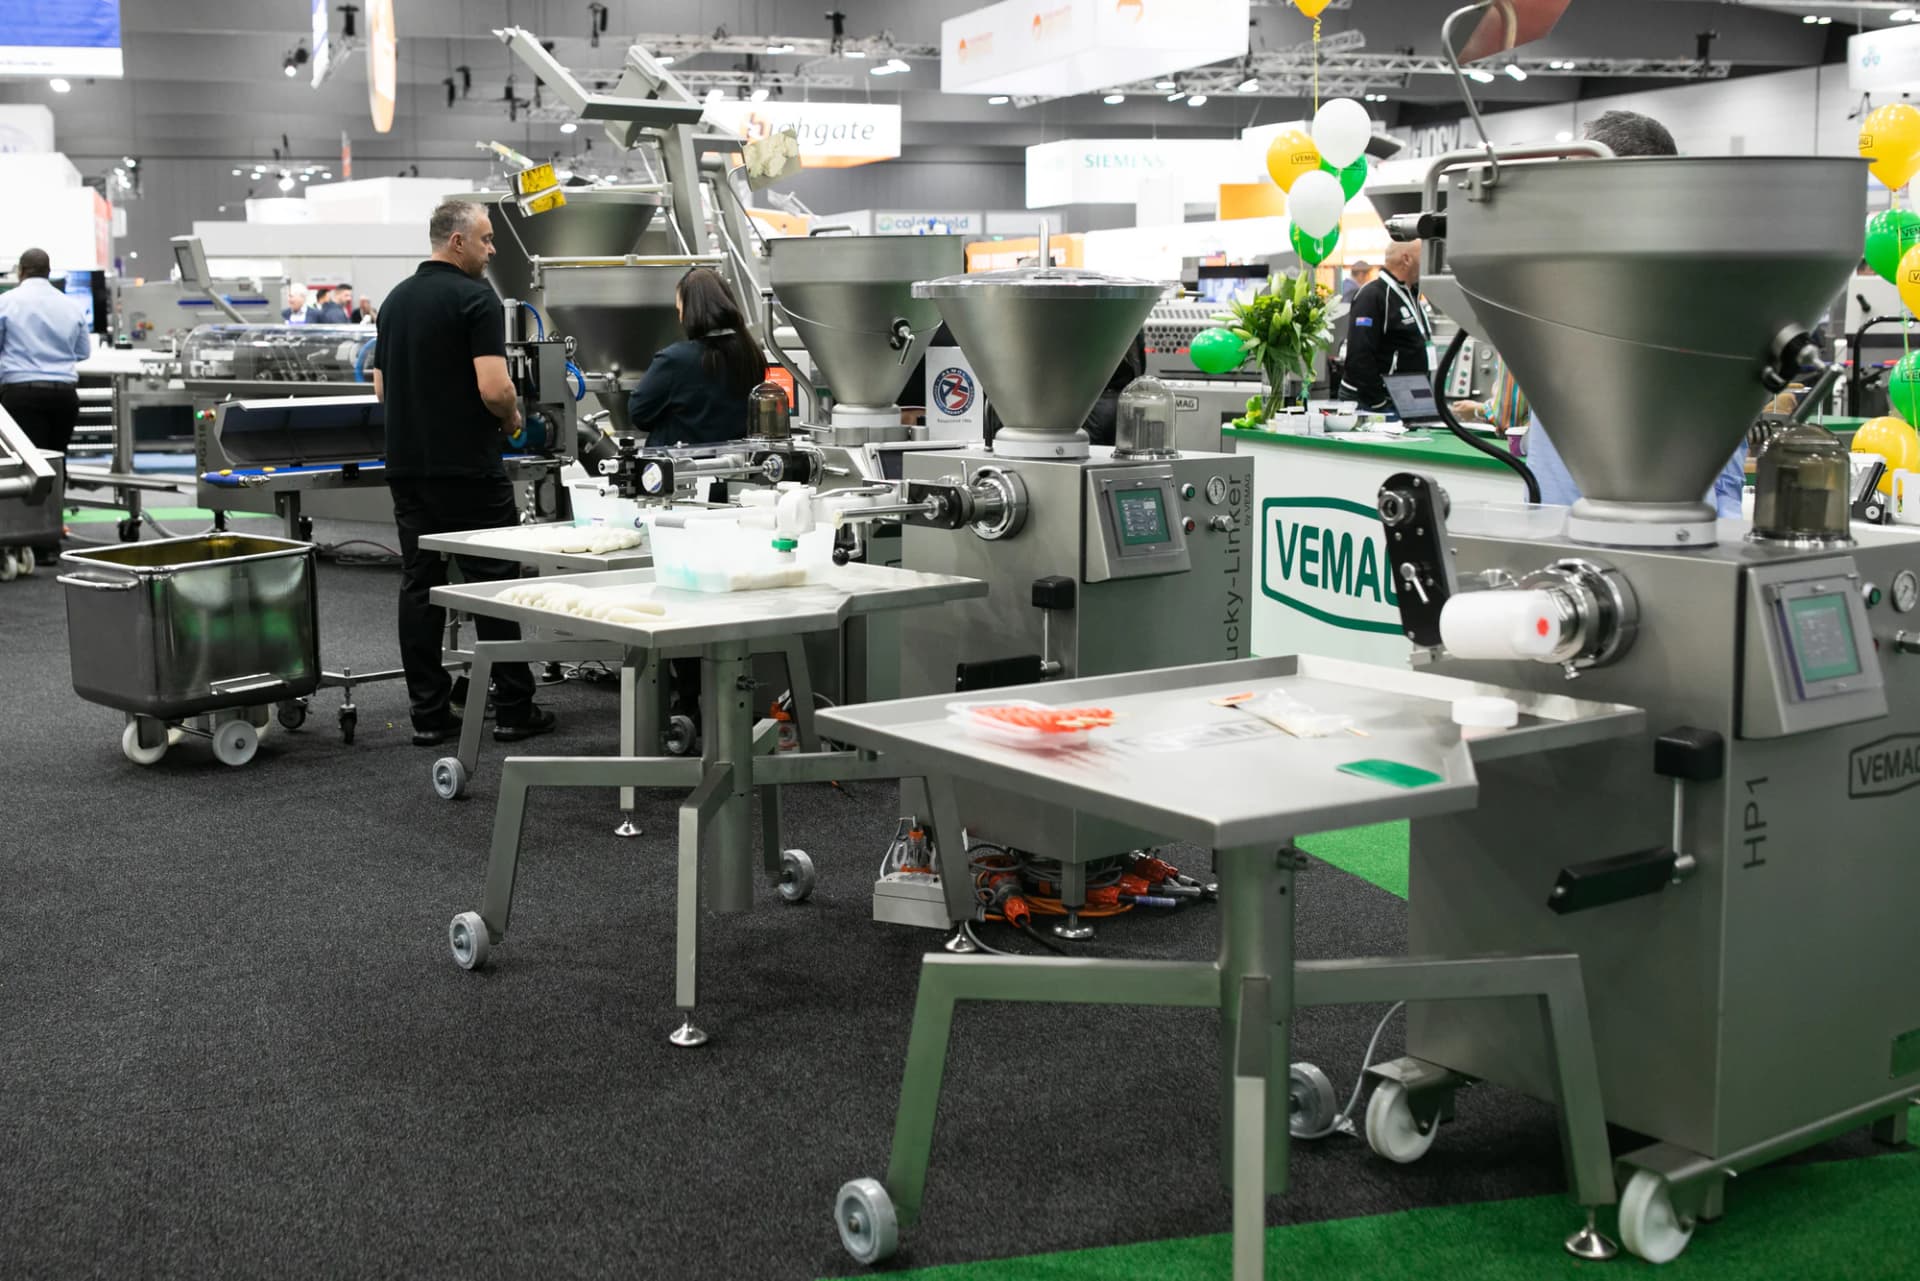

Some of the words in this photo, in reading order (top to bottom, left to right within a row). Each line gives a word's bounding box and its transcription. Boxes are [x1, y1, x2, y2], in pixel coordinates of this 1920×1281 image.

[1084, 153, 1167, 169] SIEMENS
[1295, 154, 1319, 162] VEMA
[895, 216, 969, 229] coldhield
[1743, 776, 1768, 869] HP1
